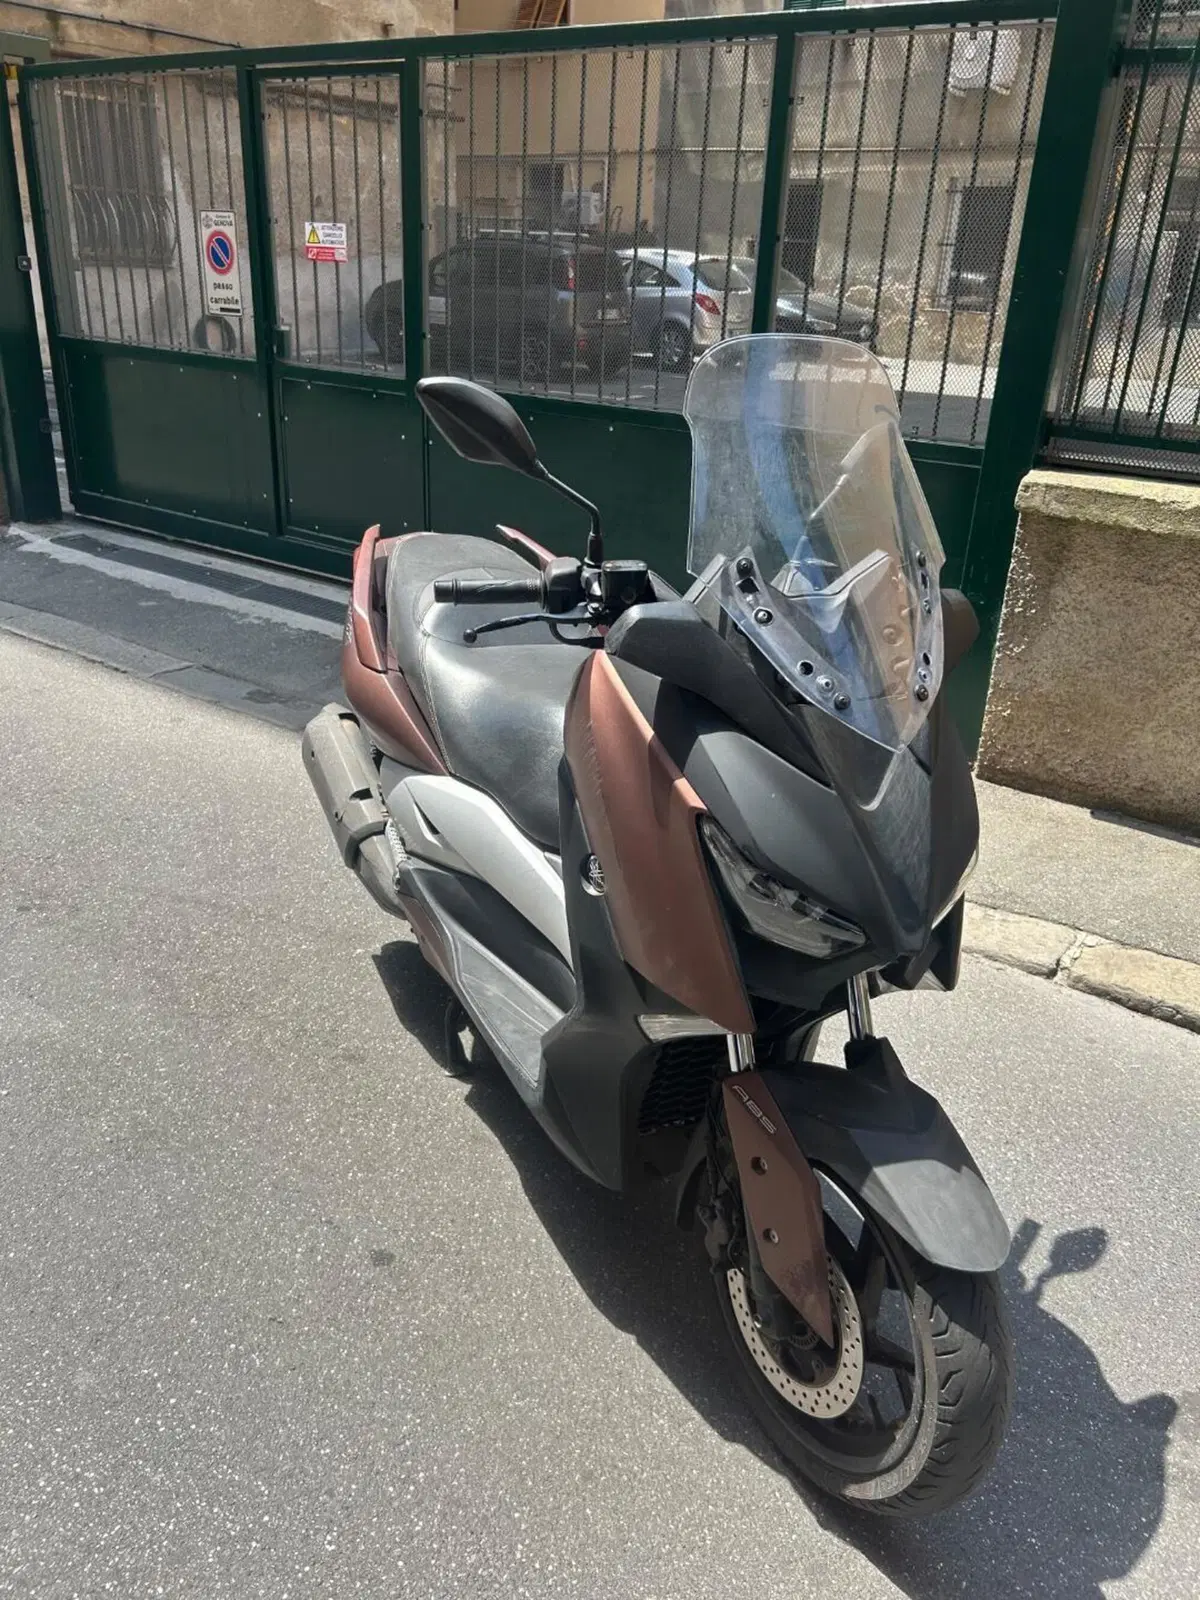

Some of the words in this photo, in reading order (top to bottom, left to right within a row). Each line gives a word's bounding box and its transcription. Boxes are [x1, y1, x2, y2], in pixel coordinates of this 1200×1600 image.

[213, 219, 233, 227] GENOVA
[213, 282, 233, 291] passo
[210, 296, 239, 305] carrabile
[732, 1085, 777, 1134] ABS
